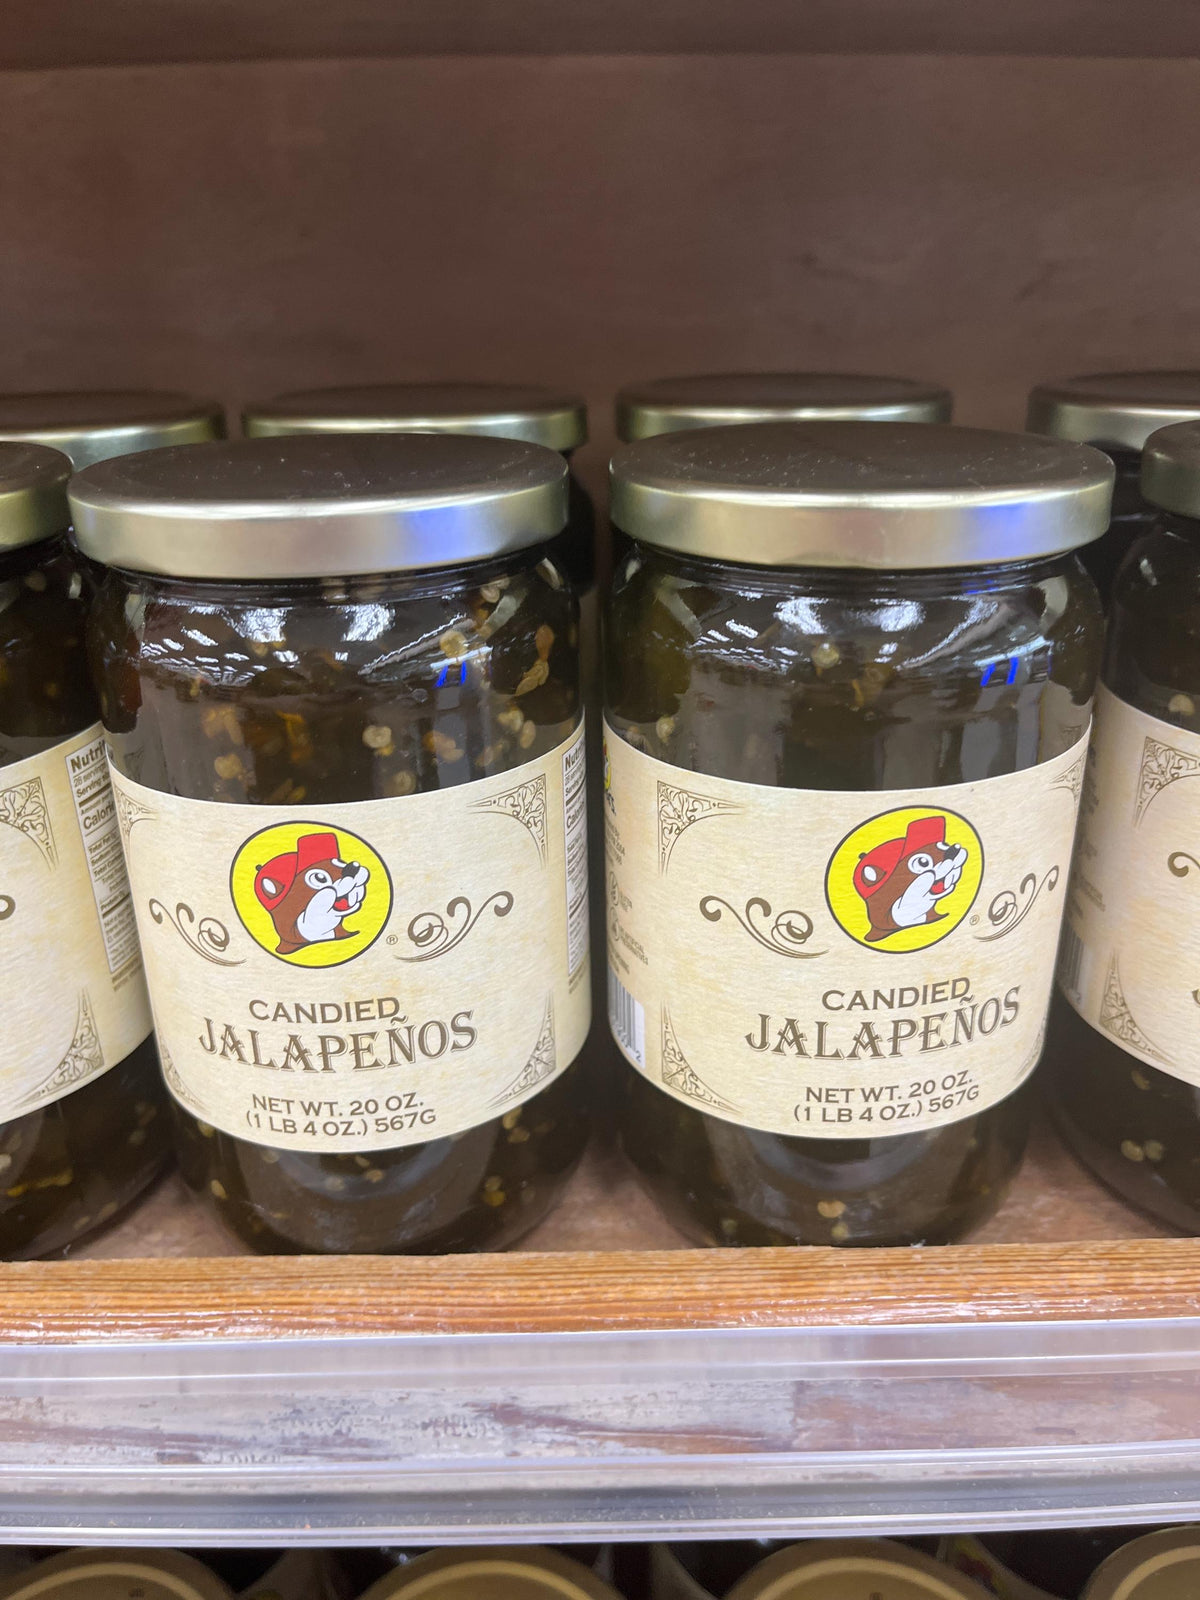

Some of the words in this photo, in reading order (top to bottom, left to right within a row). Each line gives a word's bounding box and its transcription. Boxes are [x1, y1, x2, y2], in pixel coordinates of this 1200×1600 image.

[248, 997, 400, 1024] CANDIED
[822, 977, 971, 1011] CANDIED
[745, 984, 1021, 1061] JALAPEÑOS
[198, 1009, 478, 1074] JALAPEÑOS
[794, 1104, 811, 1122] (1
[822, 1107, 853, 1123] LB
[859, 1107, 873, 1122] 4
[879, 1100, 923, 1121] OZ.)
[928, 1084, 980, 1113] 567G
[805, 1086, 855, 1104] NET
[860, 1084, 902, 1103] WT.
[908, 1079, 936, 1099] 20
[941, 1069, 973, 1091] OZ.
[252, 1093, 295, 1115] NET
[299, 1100, 343, 1117] WT.
[350, 1097, 380, 1115] 20
[385, 1092, 424, 1112] OZ.
[246, 1110, 261, 1129] (1
[269, 1115, 298, 1134] LB
[303, 1121, 318, 1136] 4
[322, 1118, 368, 1137] OZ.)
[375, 1108, 437, 1134] 567G
